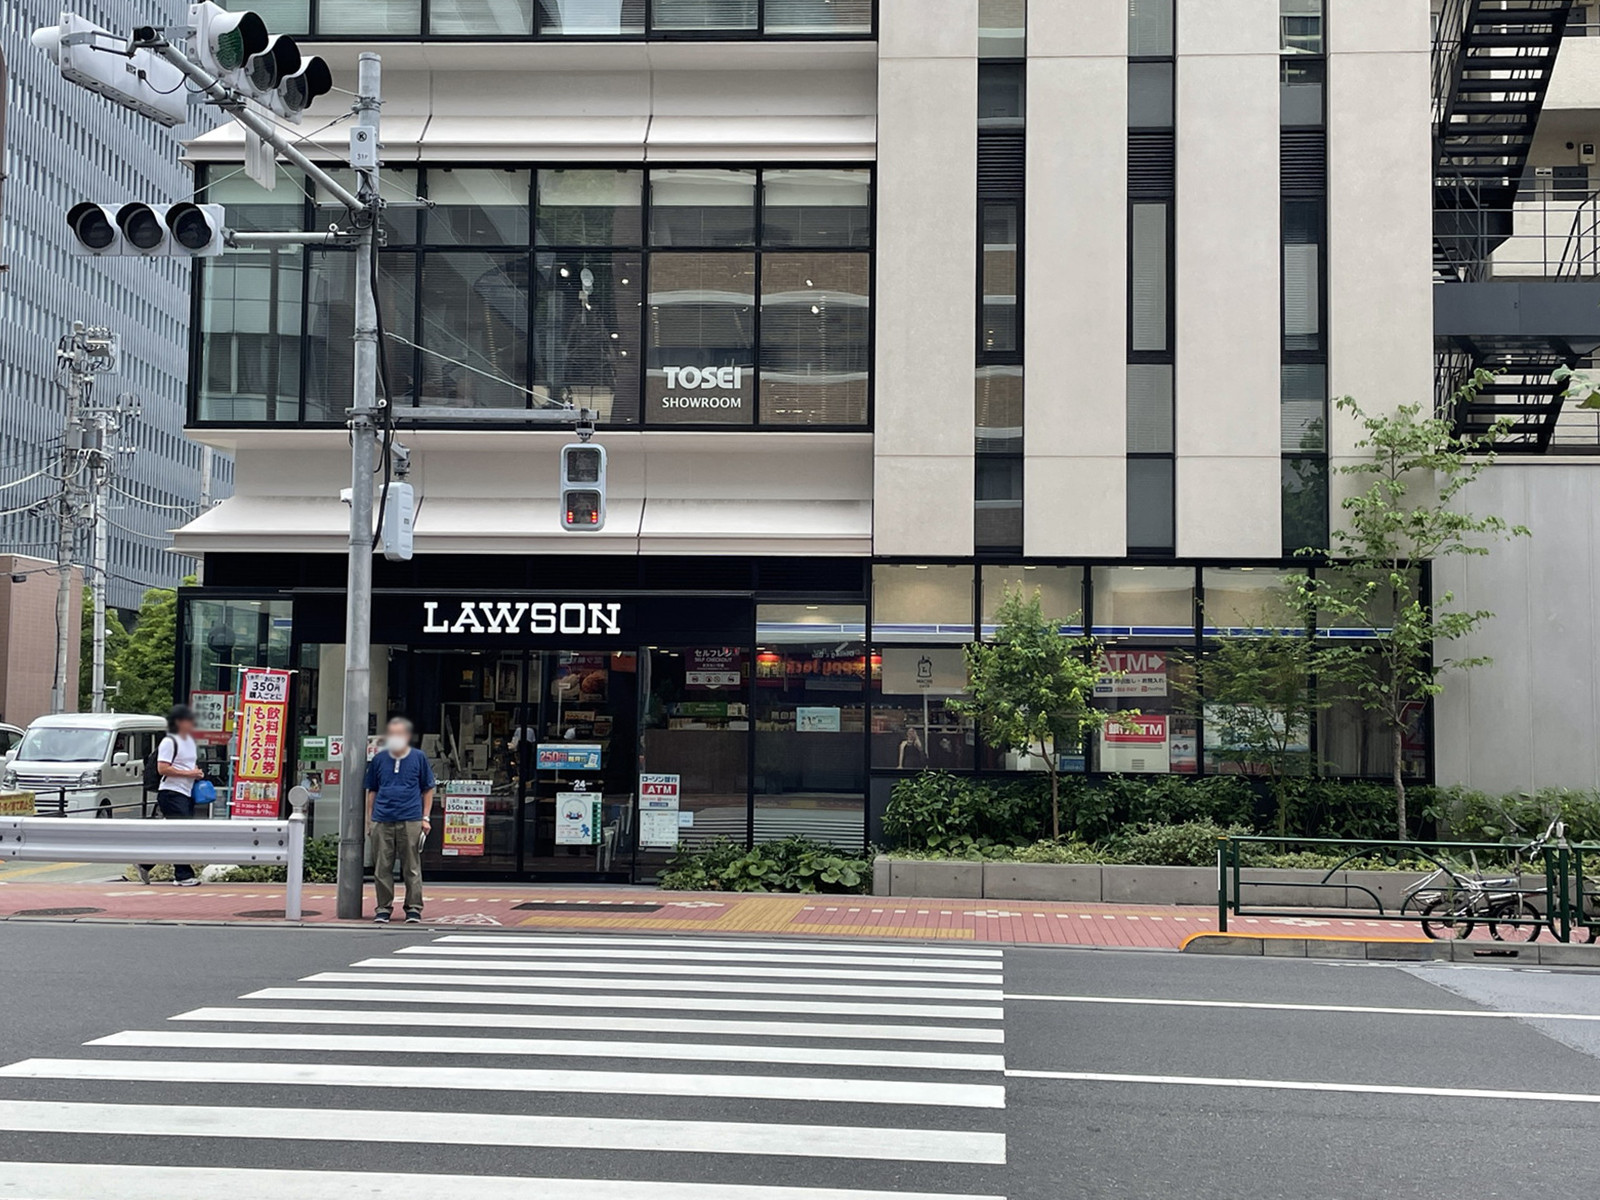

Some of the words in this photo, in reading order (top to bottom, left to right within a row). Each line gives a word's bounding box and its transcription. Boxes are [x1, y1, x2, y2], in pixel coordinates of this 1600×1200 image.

[663, 366, 742, 389] TOSEI
[662, 397, 741, 408] SHOWROOM
[423, 602, 621, 634] LAWSON
[1098, 654, 1147, 671] ATM
[252, 681, 280, 692] 350円
[262, 706, 281, 774] 飲料無料券
[647, 785, 672, 794] ATM
